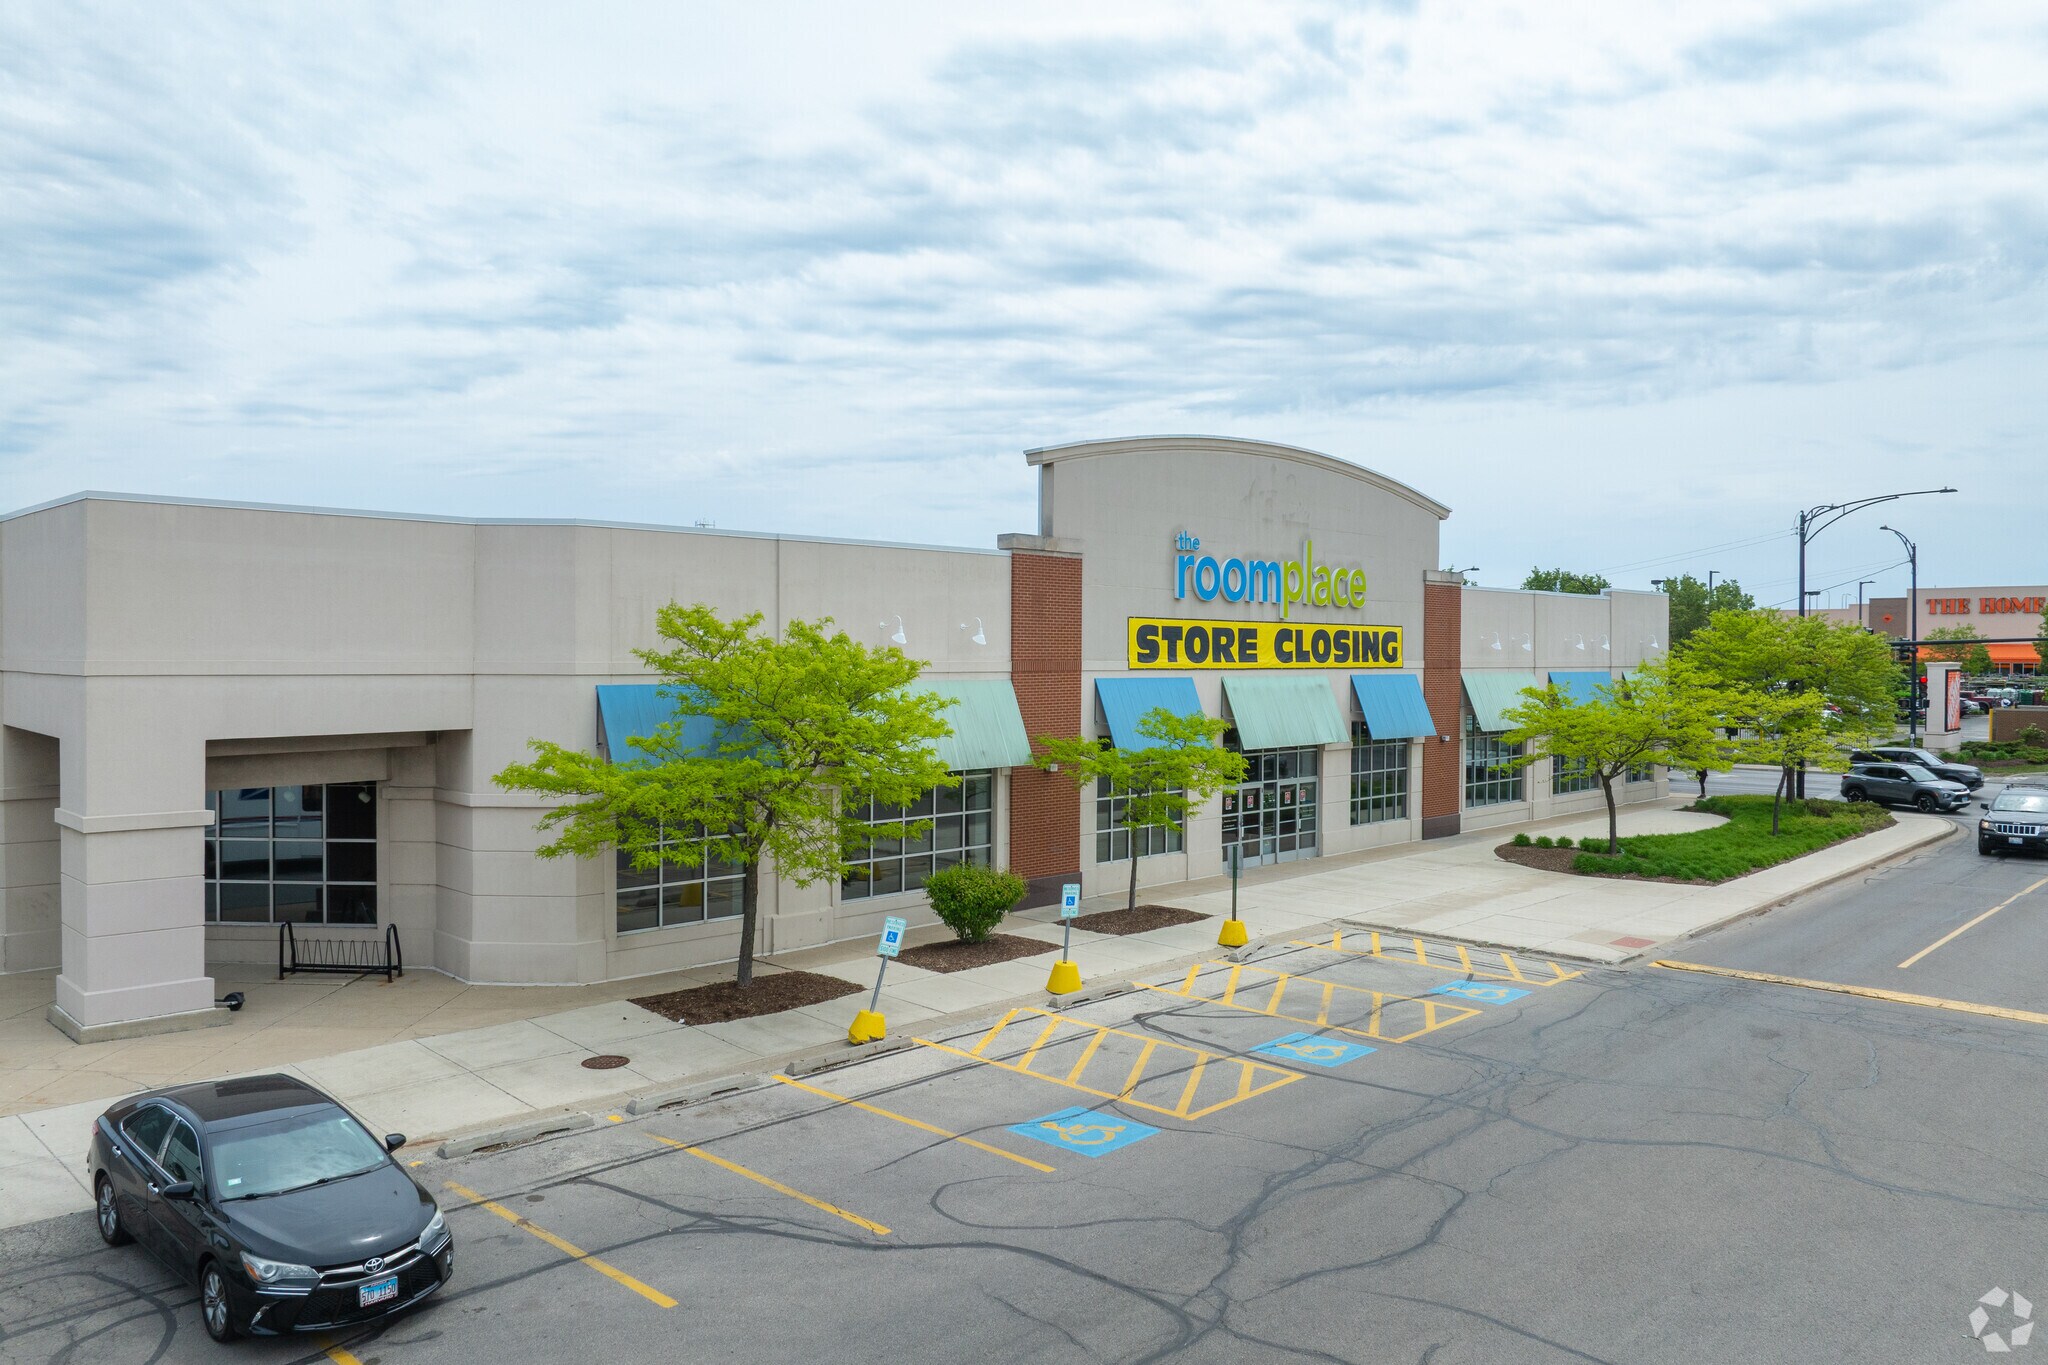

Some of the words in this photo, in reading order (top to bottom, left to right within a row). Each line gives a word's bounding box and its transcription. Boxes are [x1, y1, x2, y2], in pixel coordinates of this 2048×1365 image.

[1174, 530, 1200, 551] the
[1174, 541, 1367, 619] roomplace
[1926, 598, 1970, 615] THE
[1136, 624, 1258, 664] STORE
[1273, 628, 1398, 664] CLOSING
